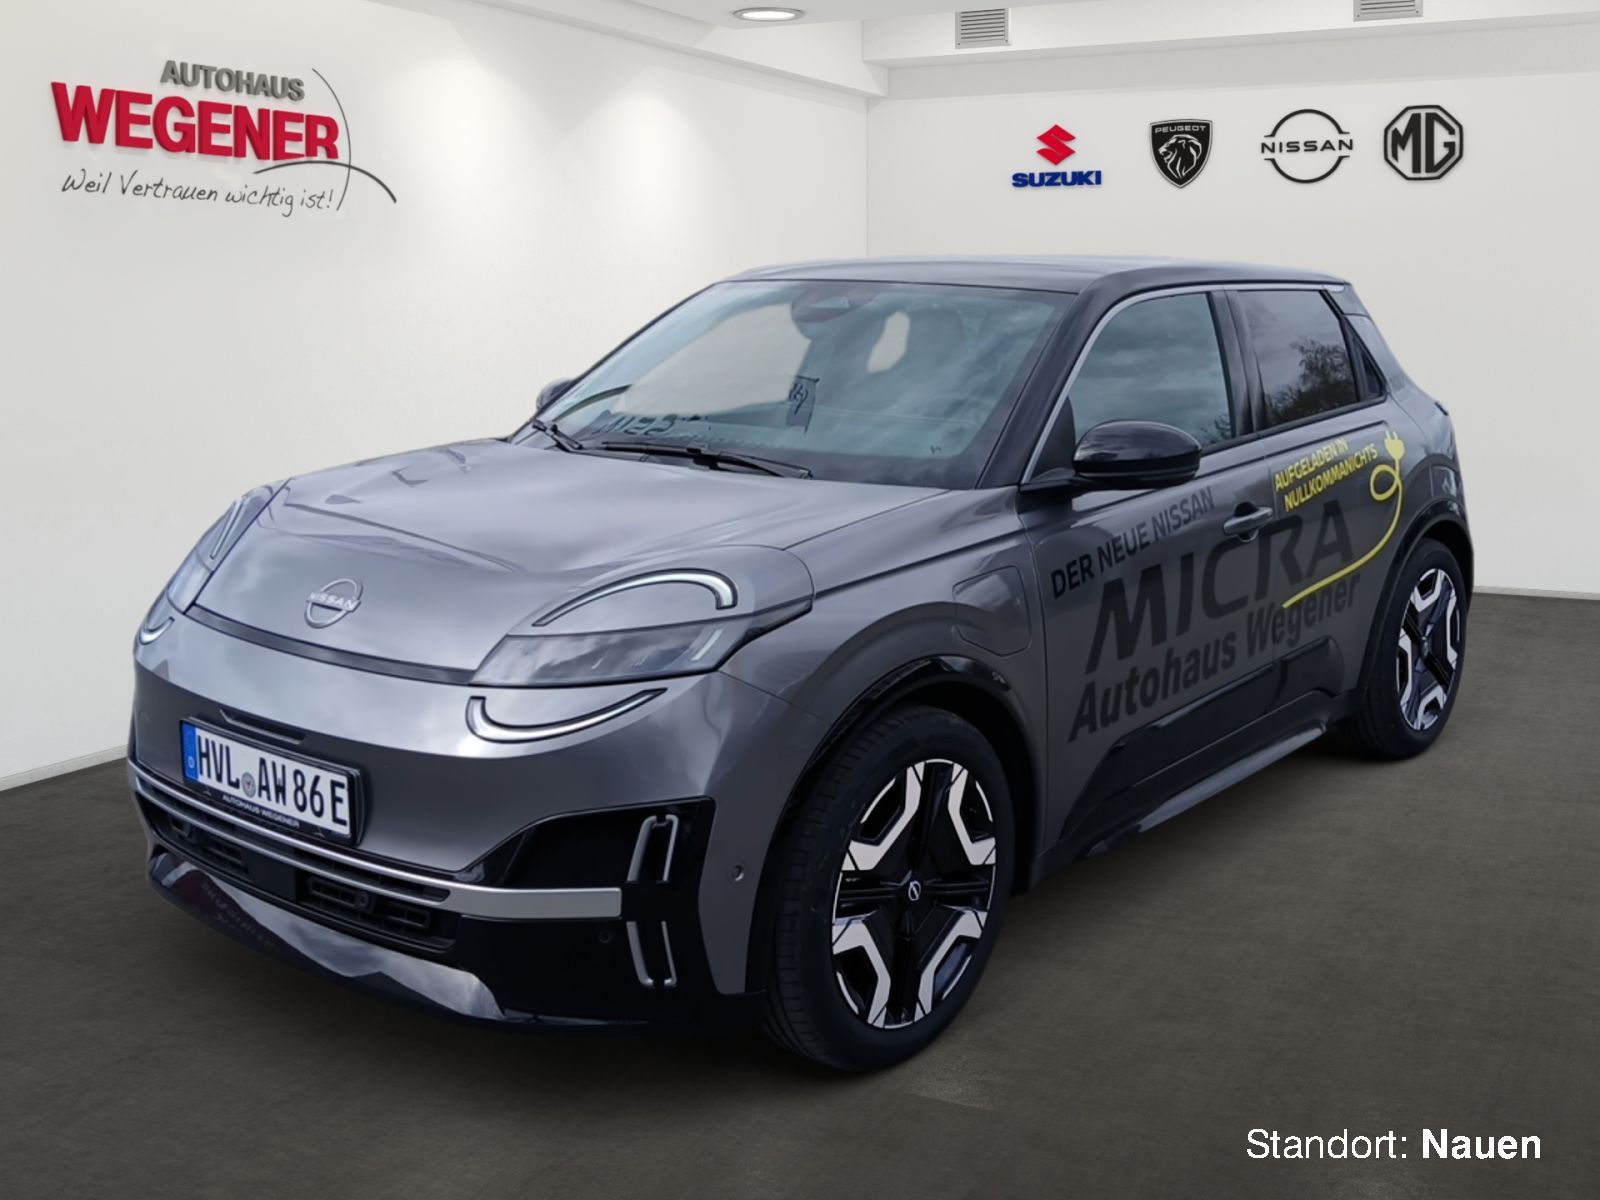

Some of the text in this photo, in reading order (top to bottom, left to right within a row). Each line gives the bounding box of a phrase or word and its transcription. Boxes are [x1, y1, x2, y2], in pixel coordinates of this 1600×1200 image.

[160, 60, 305, 101] AUTOHAUS
[51, 82, 340, 161] WEGENER
[1155, 125, 1206, 133] PEUGEOT
[1261, 139, 1353, 154] NISSAN
[1391, 112, 1456, 174] MG
[62, 168, 334, 218] Weil Vertrauen wichtig ist!
[1012, 170, 1102, 188] SUZUKI
[1275, 440, 1338, 493] AUFGELADEN
[1284, 443, 1379, 513] NULLKOMMANICHTS
[1051, 486, 1216, 599] DER NEUE NISSAN
[1084, 498, 1354, 676] MICRA
[1067, 571, 1361, 744] Autohaus Wegener
[199, 735, 240, 790] HVL
[258, 757, 286, 806] AW
